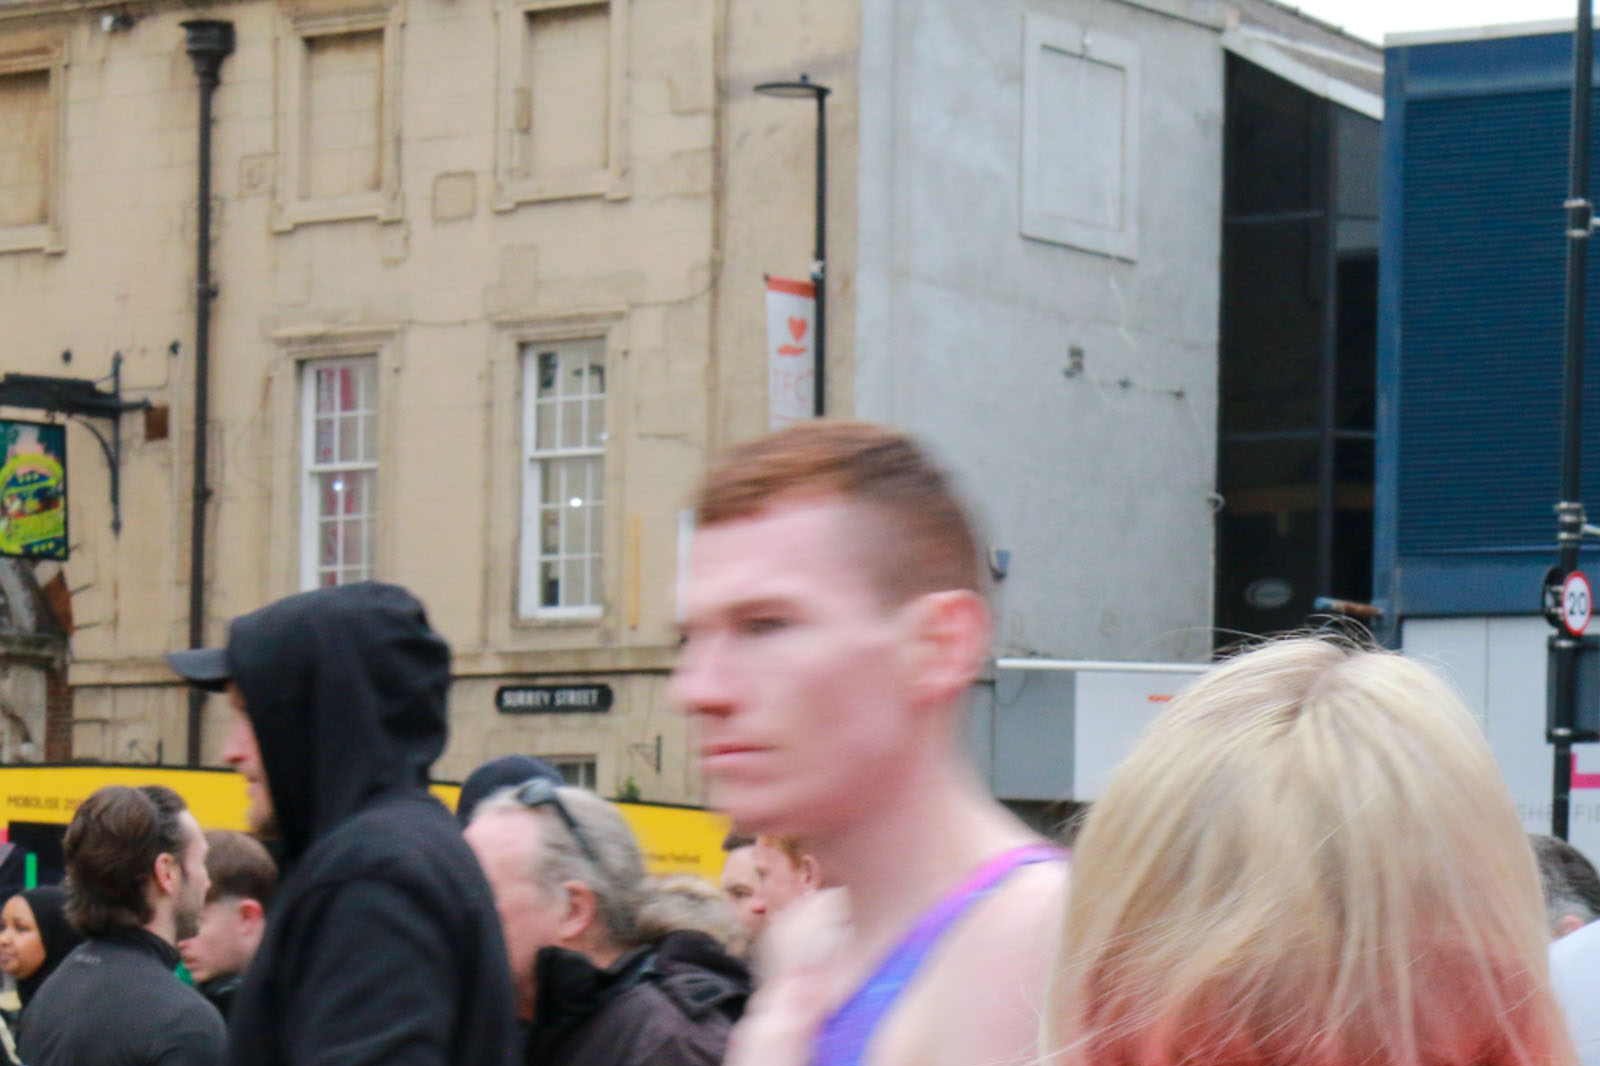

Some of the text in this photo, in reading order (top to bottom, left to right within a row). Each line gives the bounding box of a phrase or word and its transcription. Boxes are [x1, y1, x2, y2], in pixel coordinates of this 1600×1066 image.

[1567, 591, 1589, 616] 20
[503, 688, 599, 707] SURREY STREET
